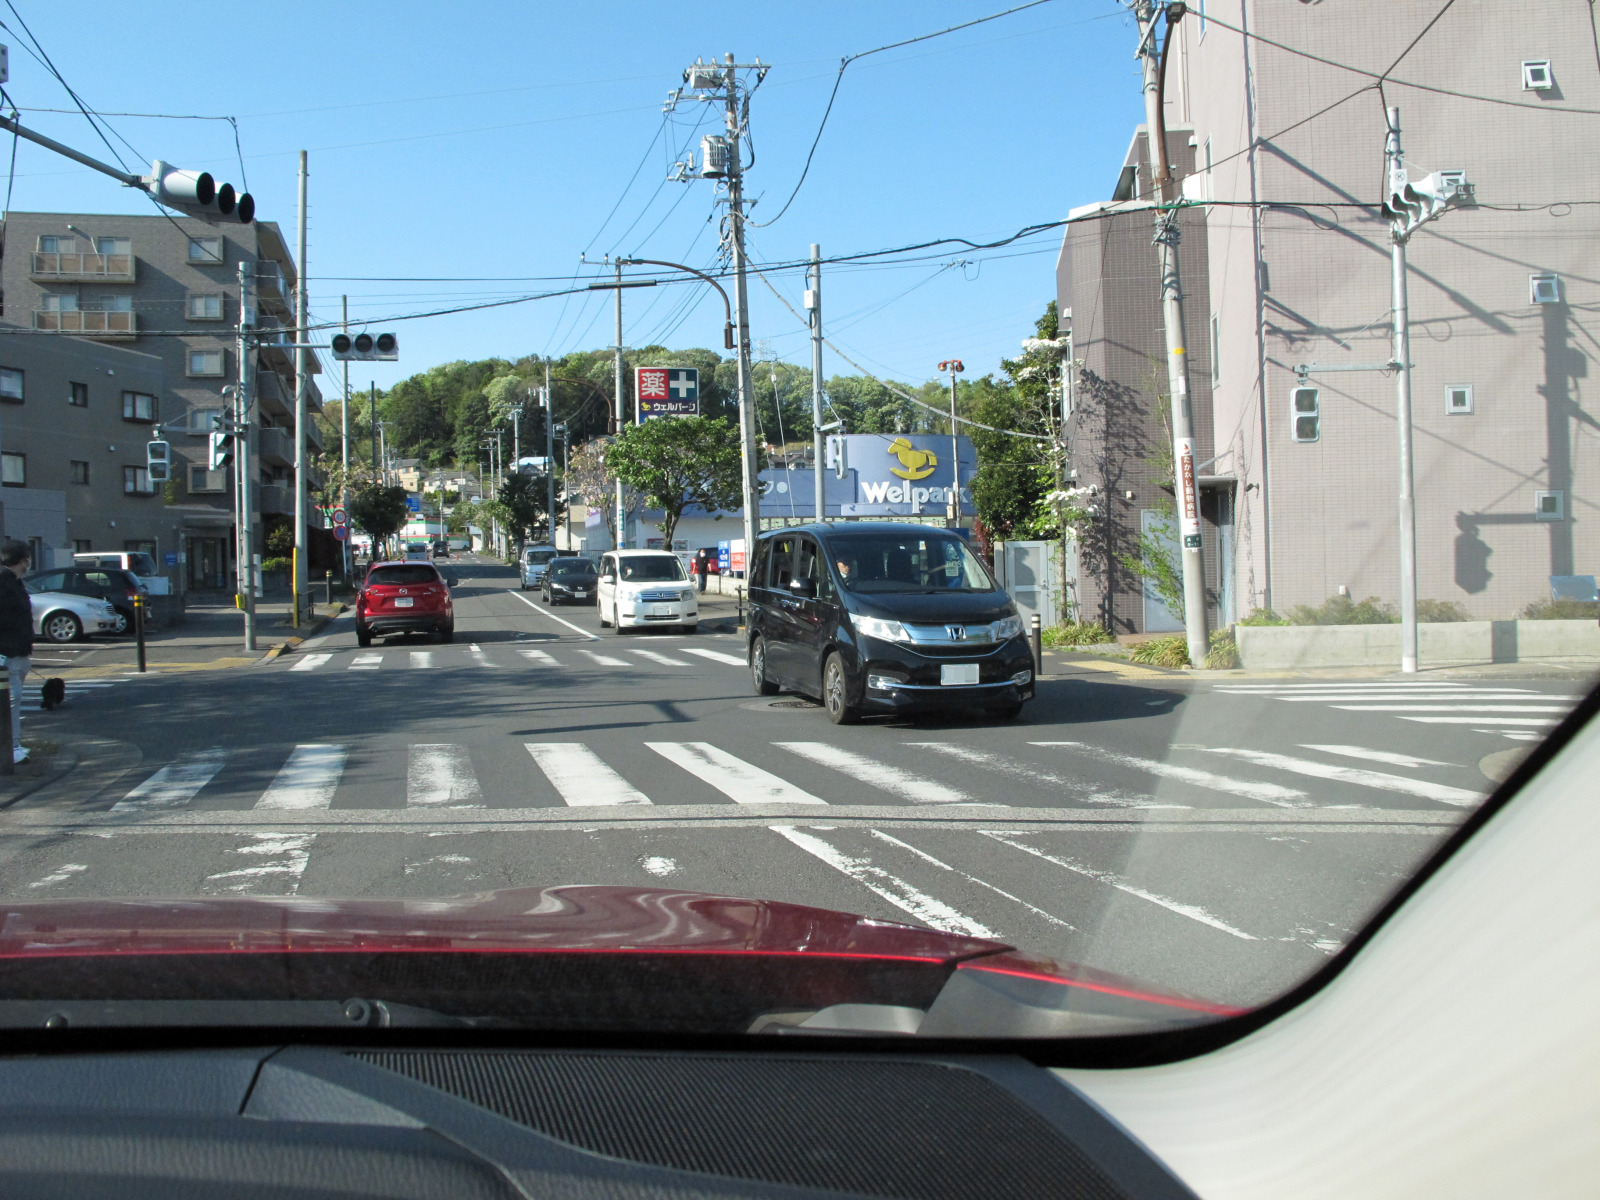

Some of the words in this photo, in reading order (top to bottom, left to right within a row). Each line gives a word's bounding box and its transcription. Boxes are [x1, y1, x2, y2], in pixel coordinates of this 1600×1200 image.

[641, 371, 665, 396] 薬
[861, 480, 969, 513] Welpark
[1183, 455, 1197, 519] たかなし動物病院
